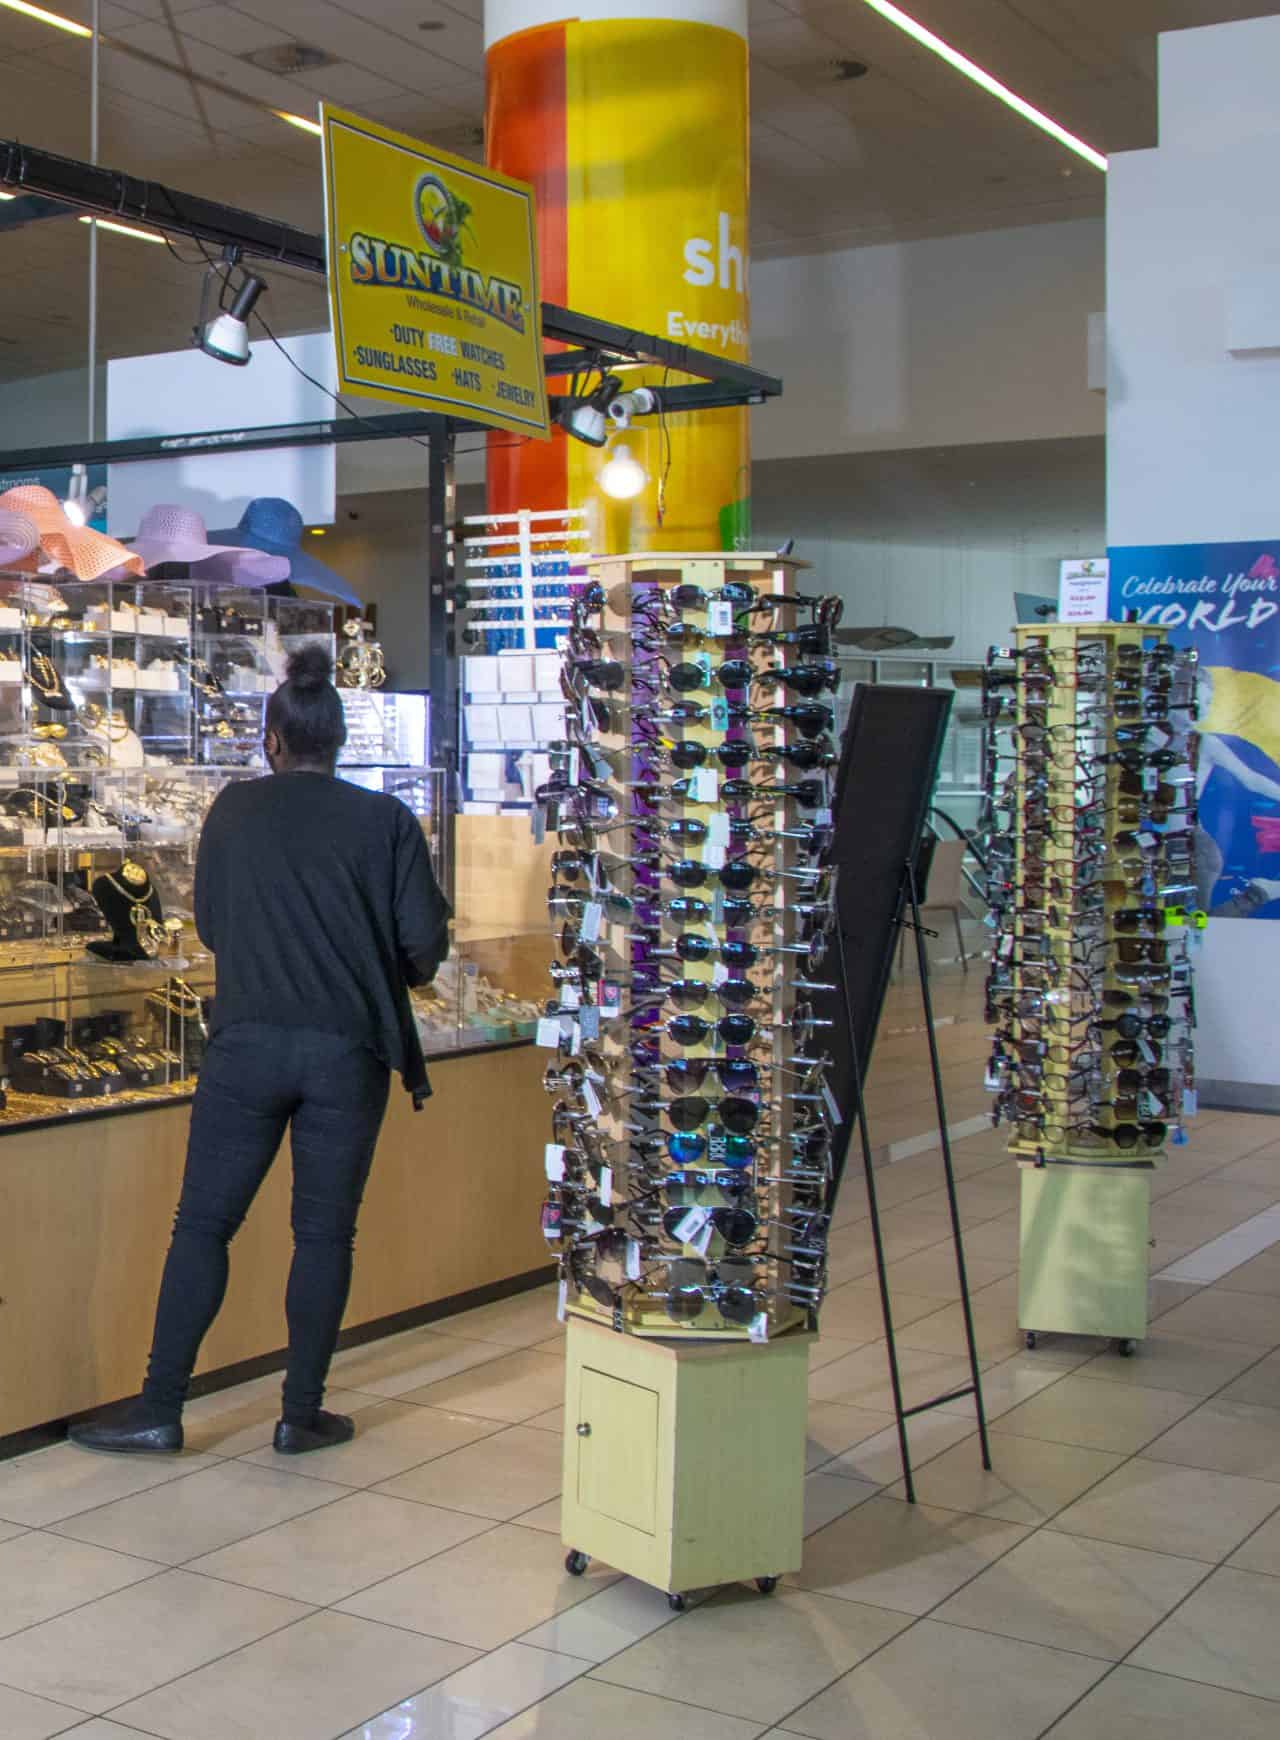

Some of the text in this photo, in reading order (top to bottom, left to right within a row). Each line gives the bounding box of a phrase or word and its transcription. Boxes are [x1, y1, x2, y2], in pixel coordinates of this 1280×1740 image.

[351, 232, 525, 334] SUNTIME
[357, 345, 536, 408] SUNGLASSES HATS JEWELRY
[460, 341, 505, 371] WATCHES
[1121, 573, 1279, 598] Celebrate Your
